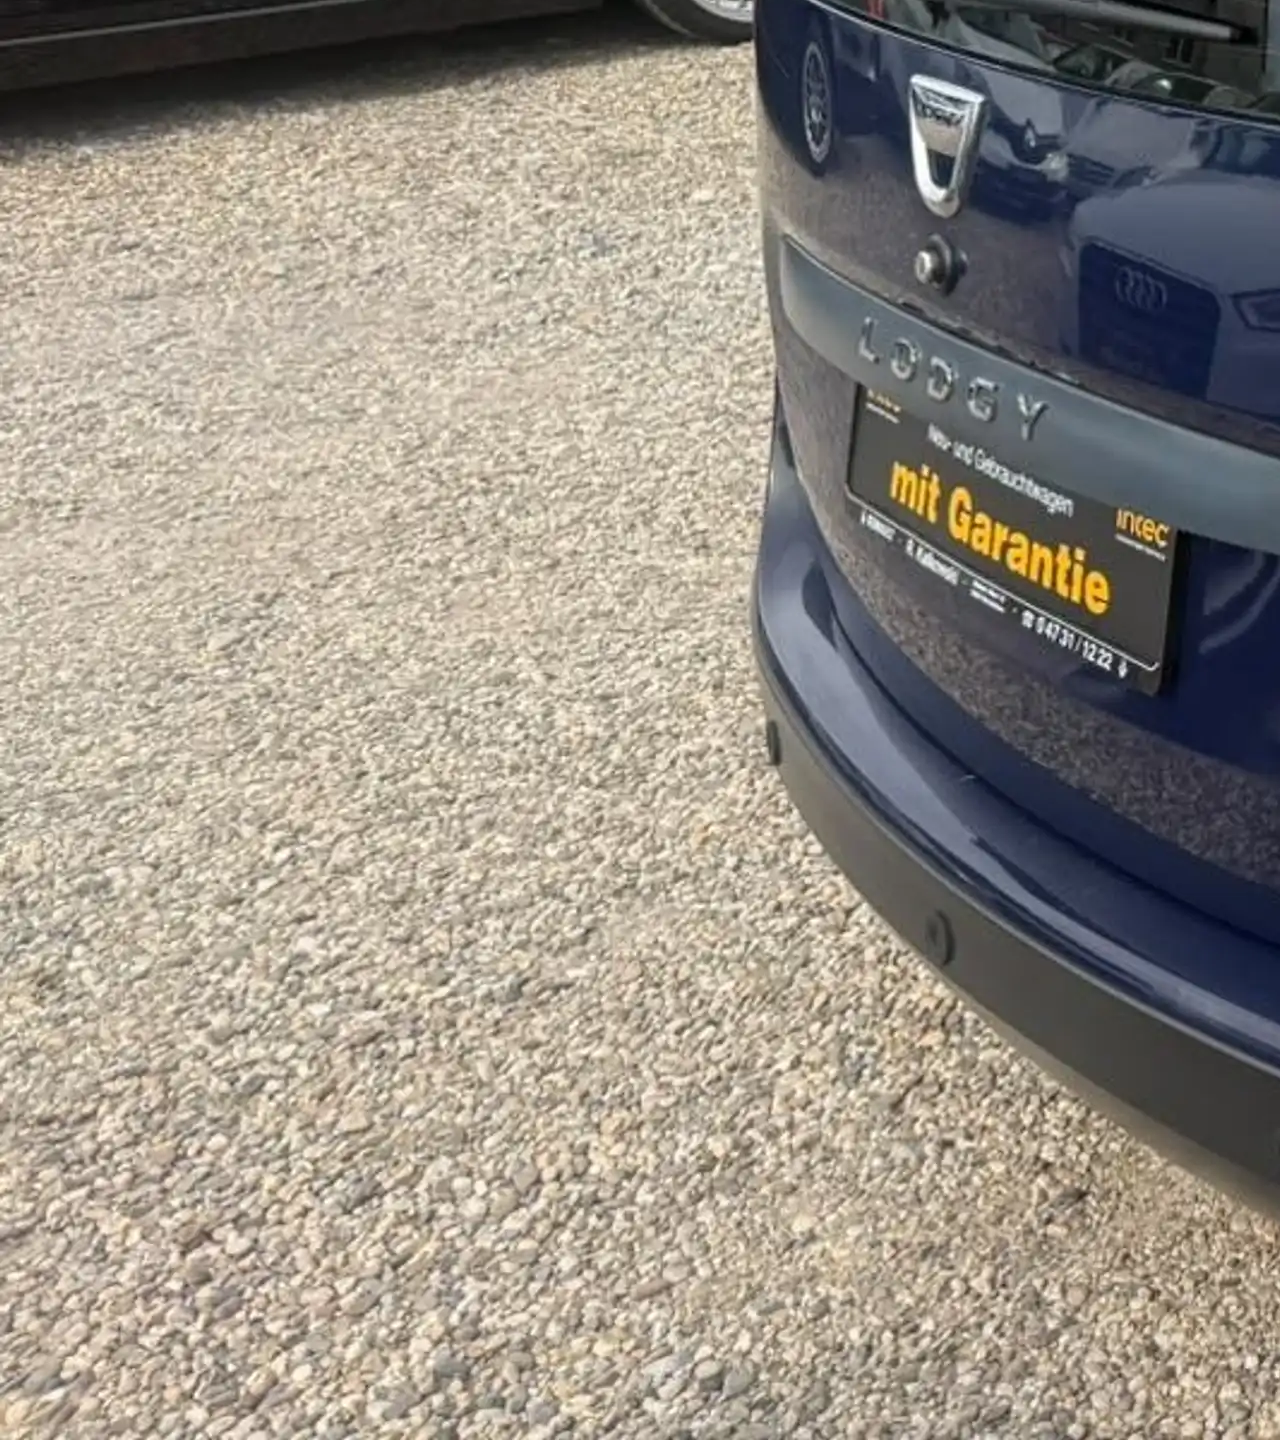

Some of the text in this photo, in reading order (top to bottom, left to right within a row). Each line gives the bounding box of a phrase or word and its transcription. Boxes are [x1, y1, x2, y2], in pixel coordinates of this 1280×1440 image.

[858, 316, 1050, 442] LODGY
[889, 460, 942, 524] mit
[947, 485, 1112, 615] Garantie
[974, 447, 1075, 518] Gebrauchtwagen
